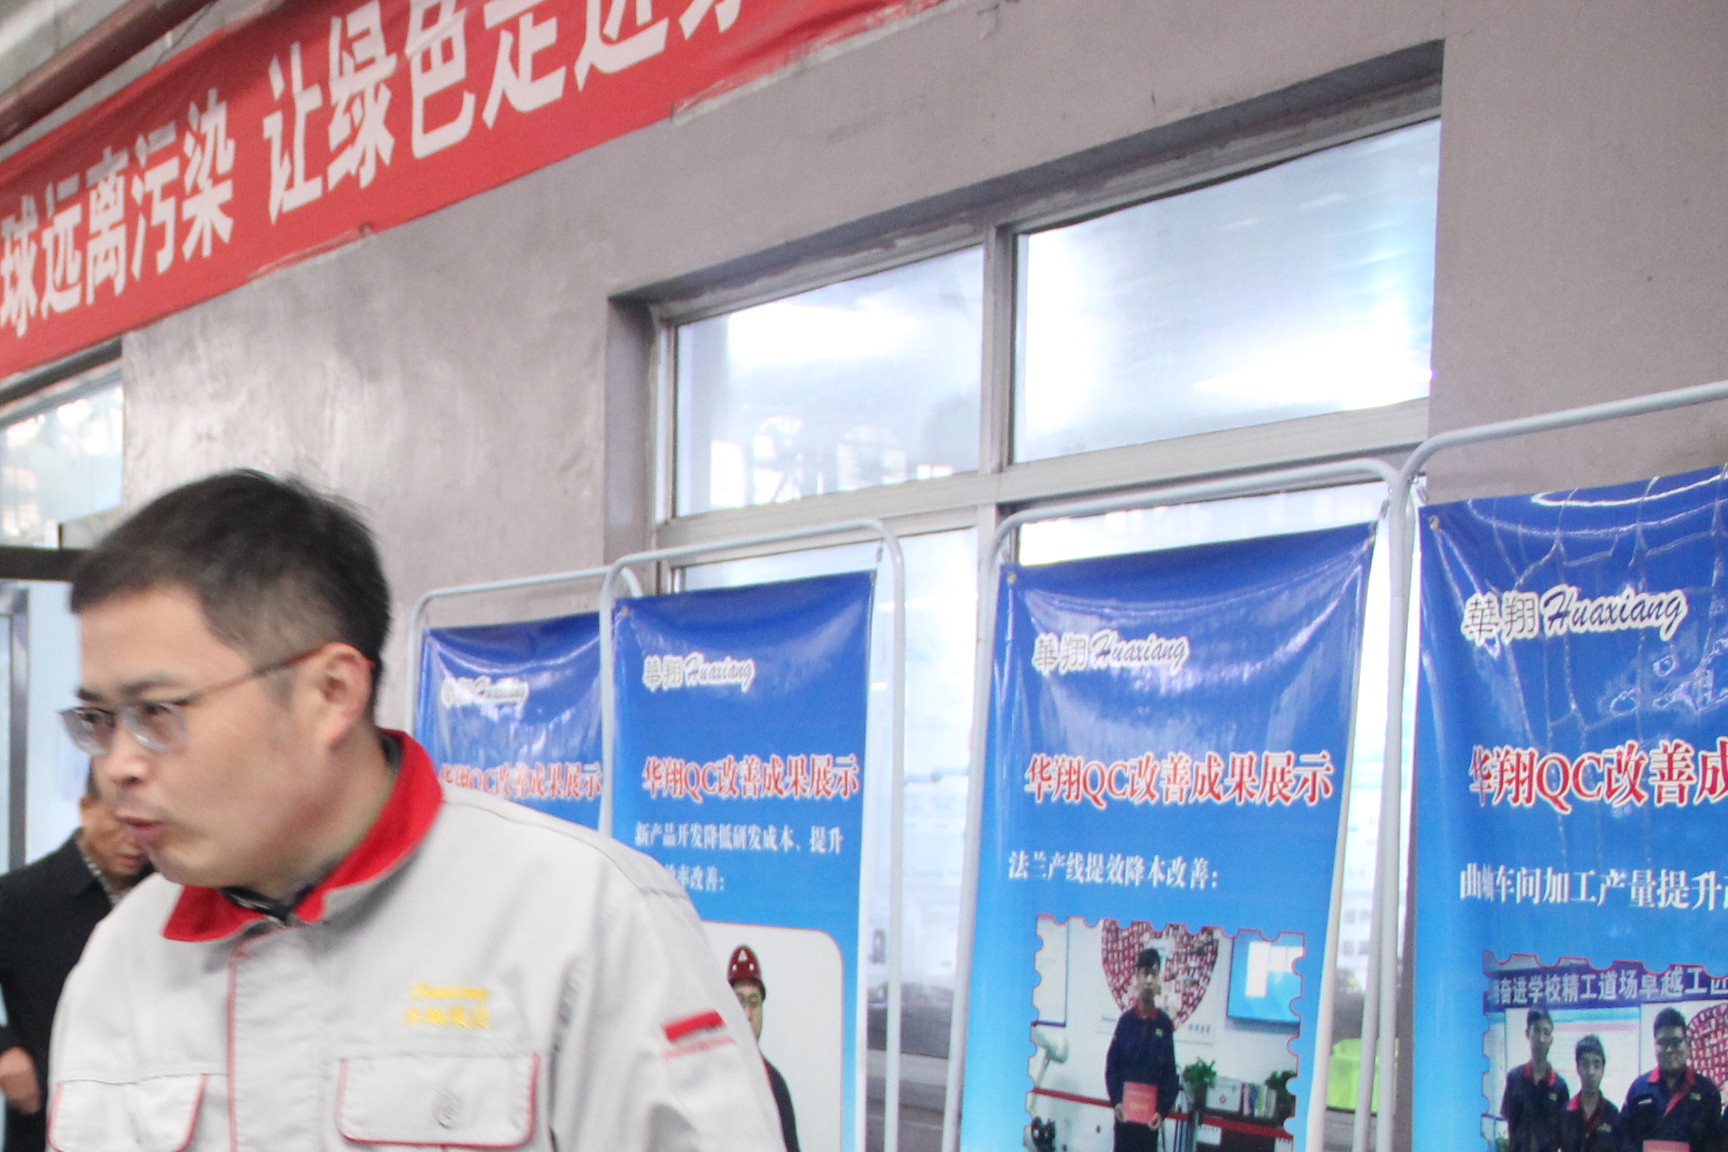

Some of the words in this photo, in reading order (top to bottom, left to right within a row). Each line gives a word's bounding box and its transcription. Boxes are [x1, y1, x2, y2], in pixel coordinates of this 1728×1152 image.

[1540, 585, 1688, 640] Huaxiang
[1090, 629, 1189, 676] Huaxiang
[642, 754, 860, 804] 华翔QC改善成果展示
[1024, 751, 1335, 810] 华翔QC改善成果展示
[1459, 862, 1728, 912] 曲轴车间加工产量提升
